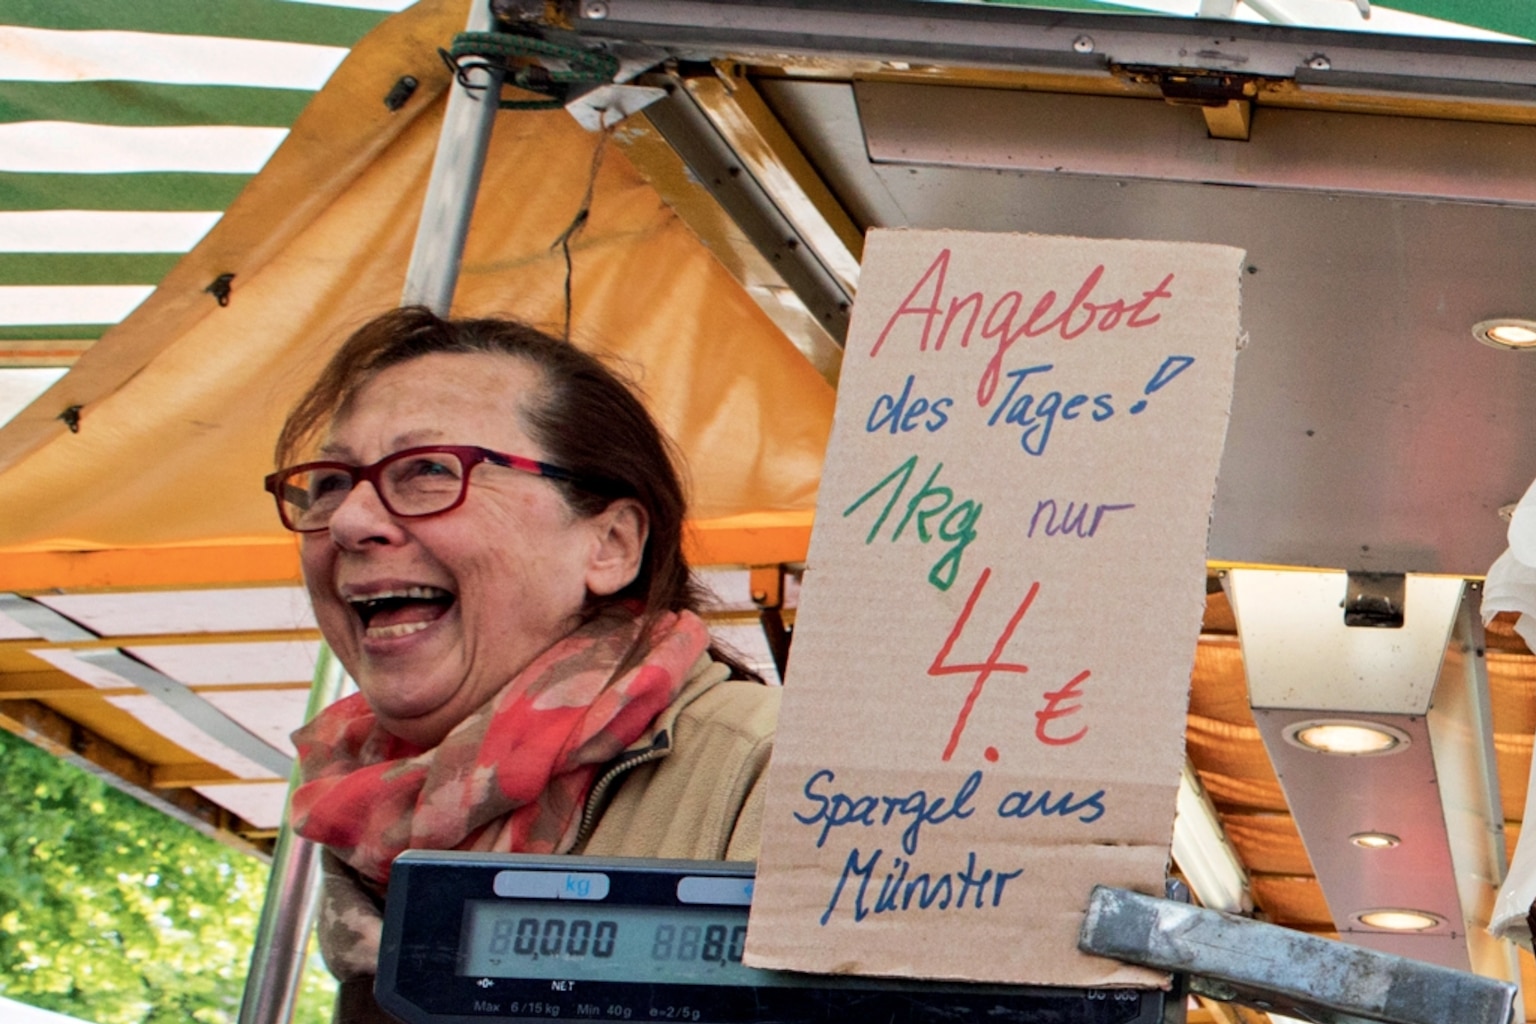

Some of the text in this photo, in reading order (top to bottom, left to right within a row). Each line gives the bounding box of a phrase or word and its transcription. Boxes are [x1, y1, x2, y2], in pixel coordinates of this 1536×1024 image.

[869, 248, 1174, 408] Angebot
[866, 355, 1196, 457] des Tages!
[1027, 499, 1135, 539] nur
[793, 769, 1106, 857] Spargel aus
[566, 874, 591, 897] kg
[551, 980, 576, 992] NET
[473, 1000, 501, 1012] Max
[577, 1003, 600, 1015] Min
